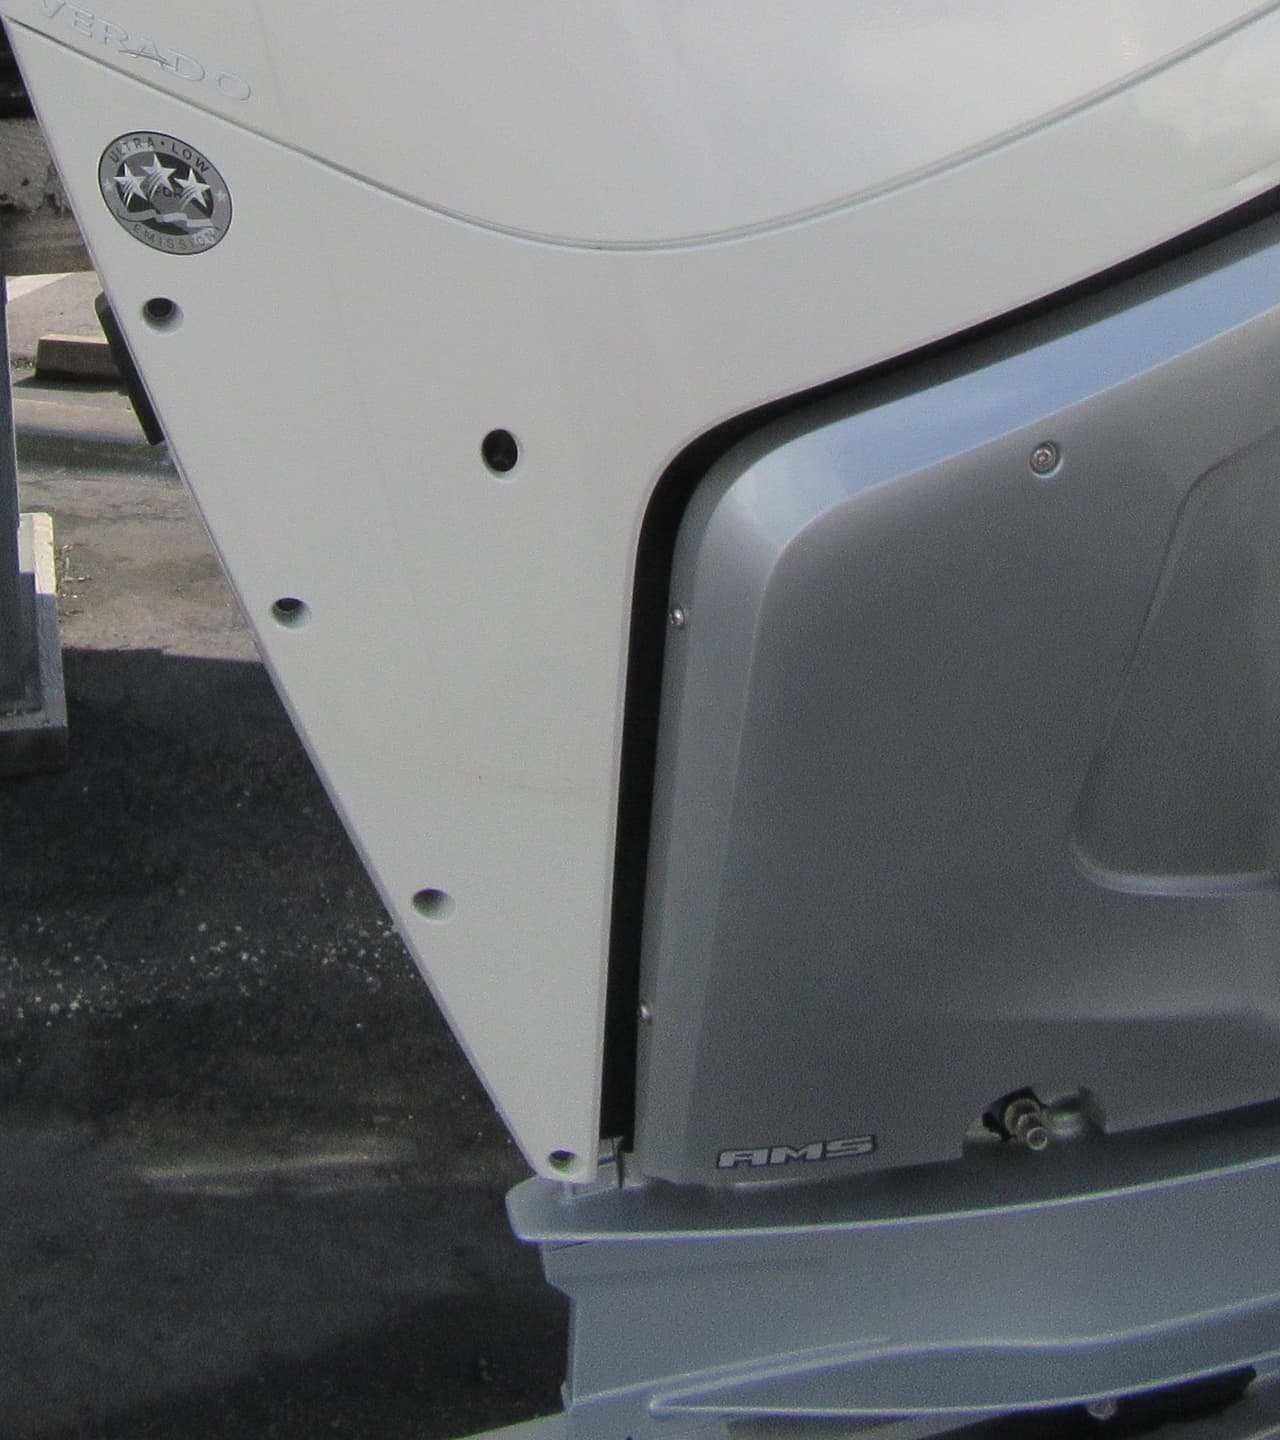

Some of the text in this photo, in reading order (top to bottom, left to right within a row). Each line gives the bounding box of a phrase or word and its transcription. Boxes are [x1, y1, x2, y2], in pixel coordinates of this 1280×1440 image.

[108, 136, 210, 173] ULTRA LOW
[717, 1134, 876, 1169] AMS
